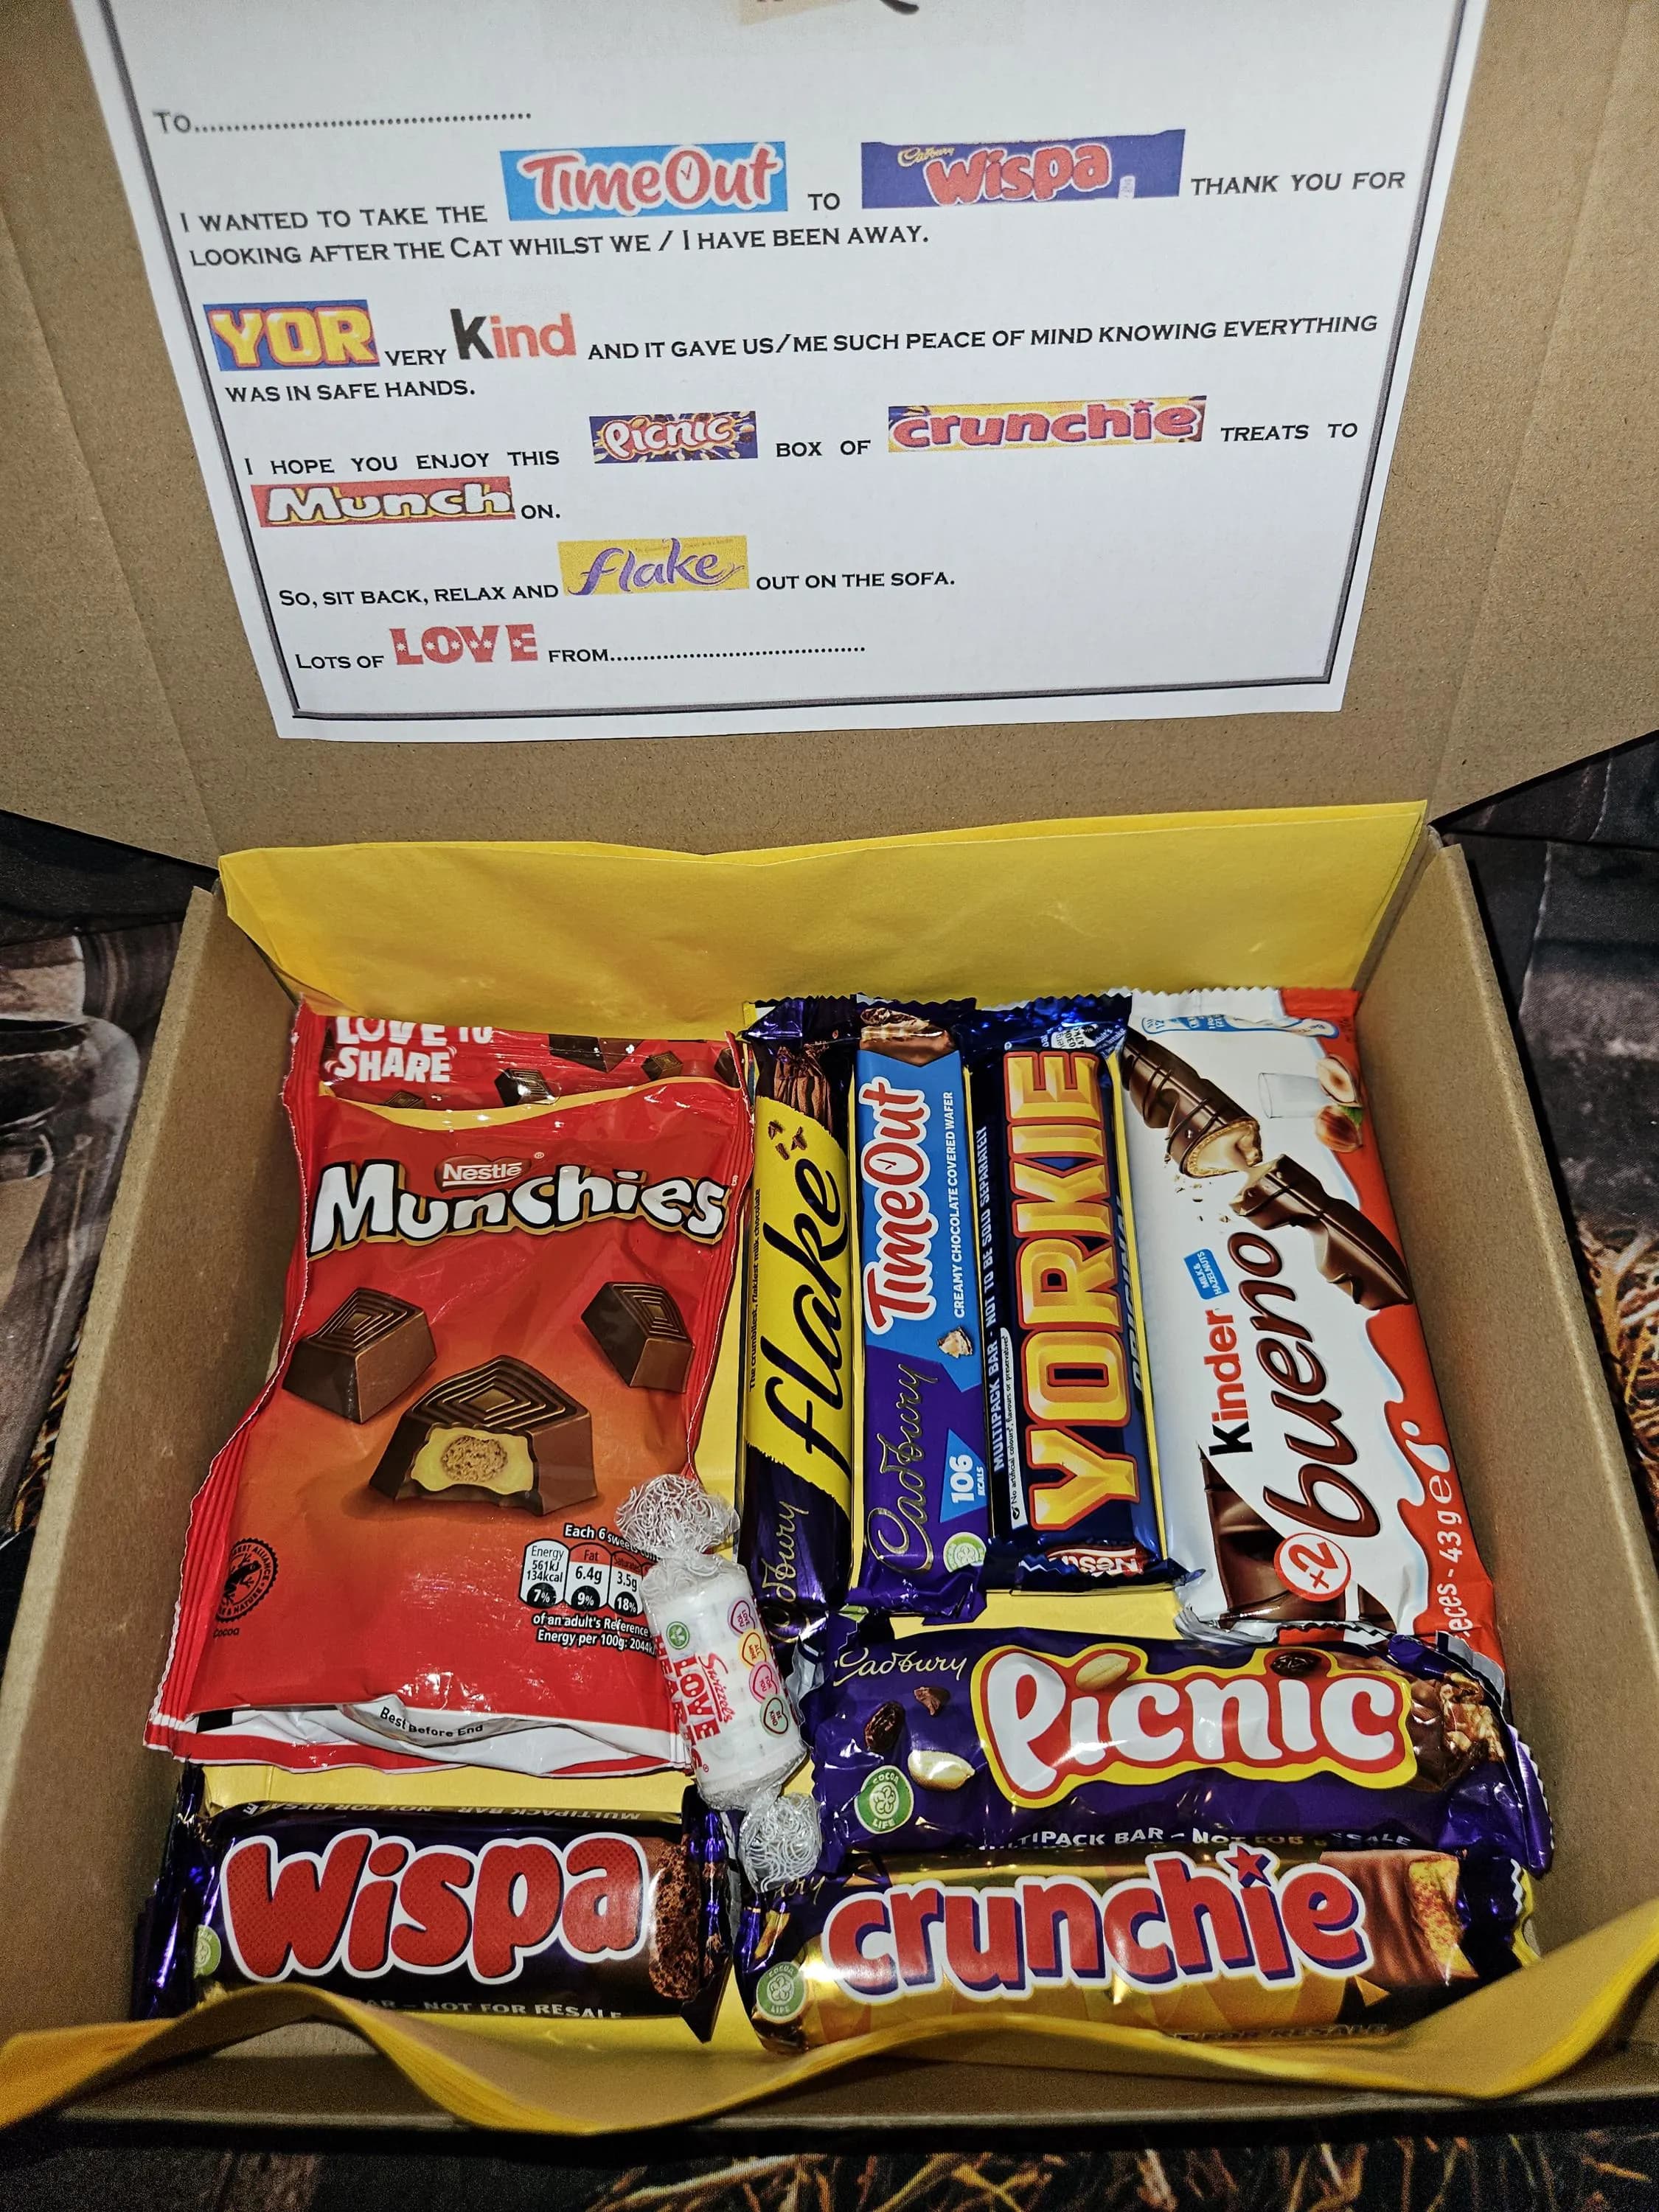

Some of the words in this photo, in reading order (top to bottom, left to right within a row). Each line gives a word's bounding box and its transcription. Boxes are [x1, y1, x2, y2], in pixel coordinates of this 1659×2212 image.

[179, 212, 189, 232] I
[198, 212, 308, 232] WANTED
[317, 209, 351, 229] TO
[359, 206, 428, 226] TAKE
[437, 204, 488, 224] THE
[808, 192, 840, 212] TO
[1191, 174, 1277, 196] THANK
[1291, 173, 1342, 191] YOU
[1352, 171, 1405, 190] FOR
[189, 246, 302, 267] LOOKING
[310, 243, 389, 263] AFTER
[394, 240, 445, 260] THE
[509, 236, 603, 257] WHILST
[610, 234, 651, 254] WE
[658, 230, 672, 253] /
[682, 229, 690, 251] I
[697, 229, 766, 249] HAVE
[772, 227, 840, 247] BEEN
[847, 225, 930, 246] AWAY.
[208, 305, 378, 367] YOR
[384, 349, 448, 367] VERY
[588, 342, 640, 361] AND
[645, 341, 666, 358] IT
[671, 339, 737, 358] GAVE
[742, 333, 829, 355] US/ME
[833, 333, 900, 352] SUCH
[905, 330, 987, 349] PEACE
[992, 330, 1023, 347] OF
[1030, 327, 1093, 347] MIND
[1099, 321, 1217, 344] KNOWING
[1223, 315, 1378, 338] EVERYTHING
[225, 386, 281, 403] WAS
[286, 385, 313, 402] IN
[316, 382, 380, 400] SAFE
[384, 380, 476, 399] HANDS.
[244, 458, 254, 476] I
[270, 458, 335, 475] HOPE
[351, 456, 399, 472] YOU
[417, 452, 490, 470] ENJOY
[507, 450, 560, 467] THIS
[599, 414, 737, 461] Picnic
[776, 441, 823, 458] BOX
[839, 439, 872, 456] OF
[1220, 423, 1310, 443] TREATS
[1327, 422, 1358, 439] TO
[265, 481, 515, 524] Munch
[521, 504, 561, 521] ON.
[279, 589, 318, 608] SO,
[323, 591, 355, 605] SIT
[361, 588, 429, 606] BACK,
[434, 586, 507, 603] RELAX
[511, 585, 560, 600] AND
[757, 574, 800, 591] OUT
[805, 573, 838, 590] ON
[841, 572, 886, 589] THE
[890, 570, 956, 587] SOFA.
[295, 653, 351, 669] LOTS
[357, 655, 384, 669] OF
[389, 622, 539, 666] LOVE
[333, 1046, 451, 1083] SHARE
[942, 1091, 956, 1130] WAFER
[945, 1131, 959, 1186] COVERED
[975, 1125, 990, 1205] SEPARATELY
[309, 1159, 730, 1256] Munchies
[859, 1076, 939, 1335] TimeOut
[948, 1188, 963, 1263] CHOCOLATE
[979, 1207, 992, 1244] SOLD
[981, 1247, 994, 1270] BE
[953, 1265, 965, 1318] CREAMY
[982, 1273, 995, 1291] TO
[1004, 1051, 1140, 1531] YORKIE
[984, 1295, 998, 1325] NOT
[986, 1340, 1001, 1375] BAR
[1228, 1232, 1381, 1538] bueno
[988, 1380, 1005, 1472] MULTIPACK
[867, 1363, 939, 1575] Cadbury
[948, 1454, 975, 1503] 106
[977, 1465, 985, 1497] KCALS
[564, 1524, 595, 1540] Each
[598, 1528, 606, 1540] 6
[1437, 1509, 1463, 1525] g
[531, 1545, 564, 1561] Energy
[532, 1559, 560, 1572] 561kJ
[583, 1549, 599, 1562] Fat
[1436, 1531, 1464, 1564] 43
[526, 1570, 563, 1583] 134kcal
[575, 1565, 603, 1585] 6.4g
[616, 1571, 638, 1593] 3.5g
[533, 1588, 551, 1604] 7%
[577, 1592, 595, 1607] 9%
[616, 1596, 637, 1613] 18%
[533, 1612, 546, 1625] of
[547, 1616, 562, 1627] an
[563, 1615, 602, 1629] adult's
[603, 1618, 650, 1637] Reference
[538, 1629, 577, 1646] Energy
[578, 1634, 598, 1646] per
[600, 1633, 628, 1651] 100g:
[832, 1649, 968, 1687] Cadbury
[672, 1653, 721, 1741] LOVE
[380, 1706, 406, 1731] Best
[408, 1723, 453, 1737] Before
[457, 1724, 484, 1736] End
[979, 1647, 1410, 1801] Picnic
[872, 1772, 900, 1785] COCOA
[872, 1818, 896, 1829] LIFE
[1114, 1827, 1164, 1845] BAR
[821, 1842, 1374, 2001] crunchie
[424, 2000, 473, 2012] NOT
[480, 2003, 526, 2014] FOR
